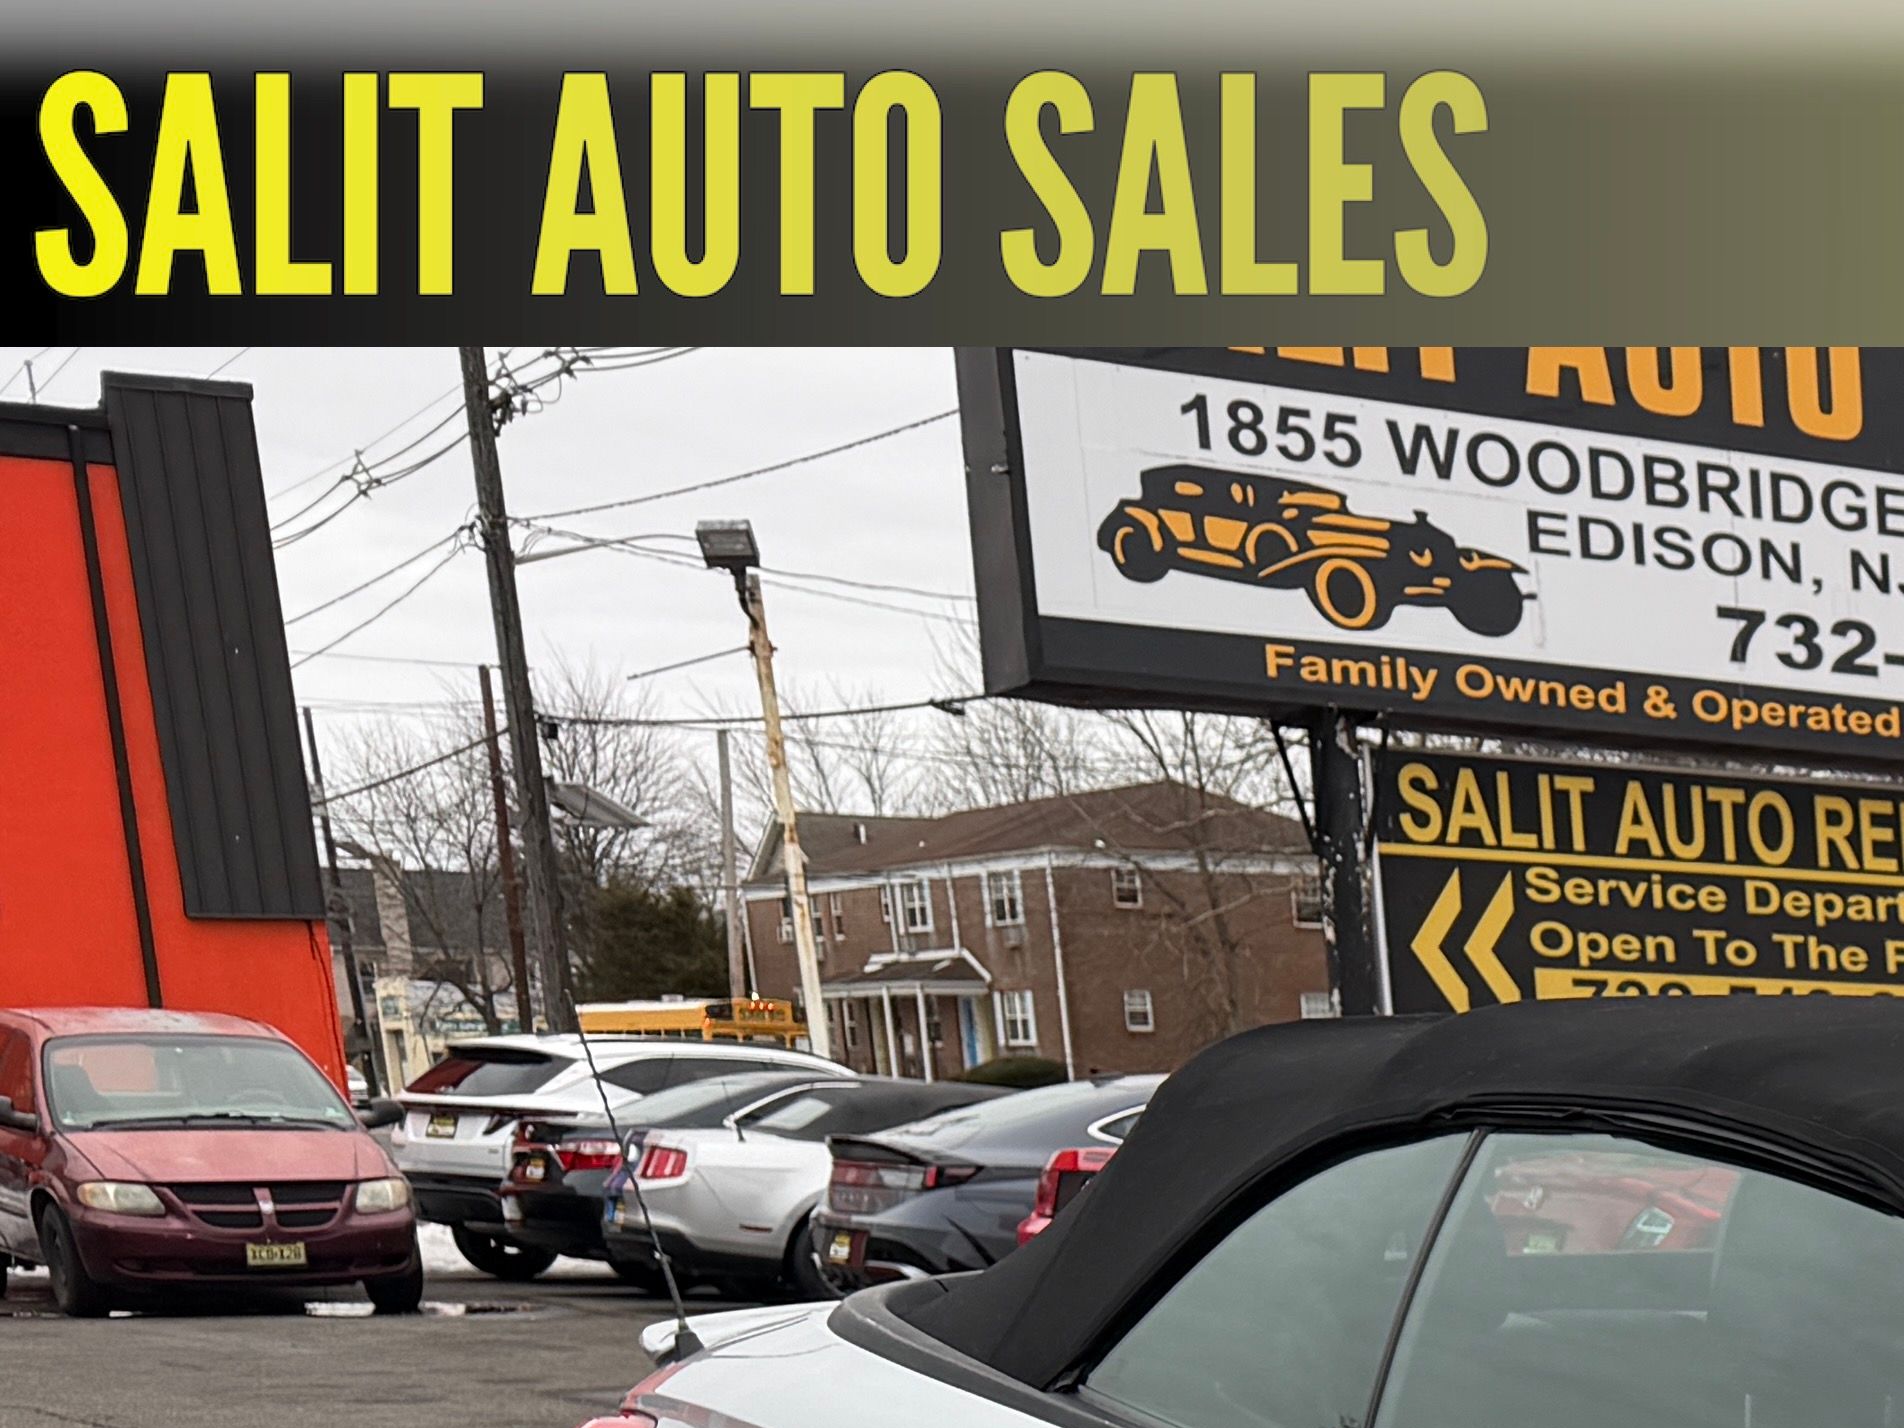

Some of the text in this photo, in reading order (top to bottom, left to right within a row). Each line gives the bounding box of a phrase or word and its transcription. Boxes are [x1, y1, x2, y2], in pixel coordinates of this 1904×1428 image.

[1180, 393, 1363, 469] 1855
[1526, 509, 1823, 596] EDISON,
[1264, 644, 1439, 699] Family
[1455, 664, 1627, 714] Owned
[1644, 685, 1678, 720] &
[1691, 689, 1901, 739] Operated
[1398, 762, 1594, 852] SALIT
[1615, 782, 1796, 866] AUTO
[1523, 866, 1727, 913] Service
[1528, 920, 1676, 969] Open
[1693, 929, 1758, 968] To
[1773, 934, 1869, 973] The
